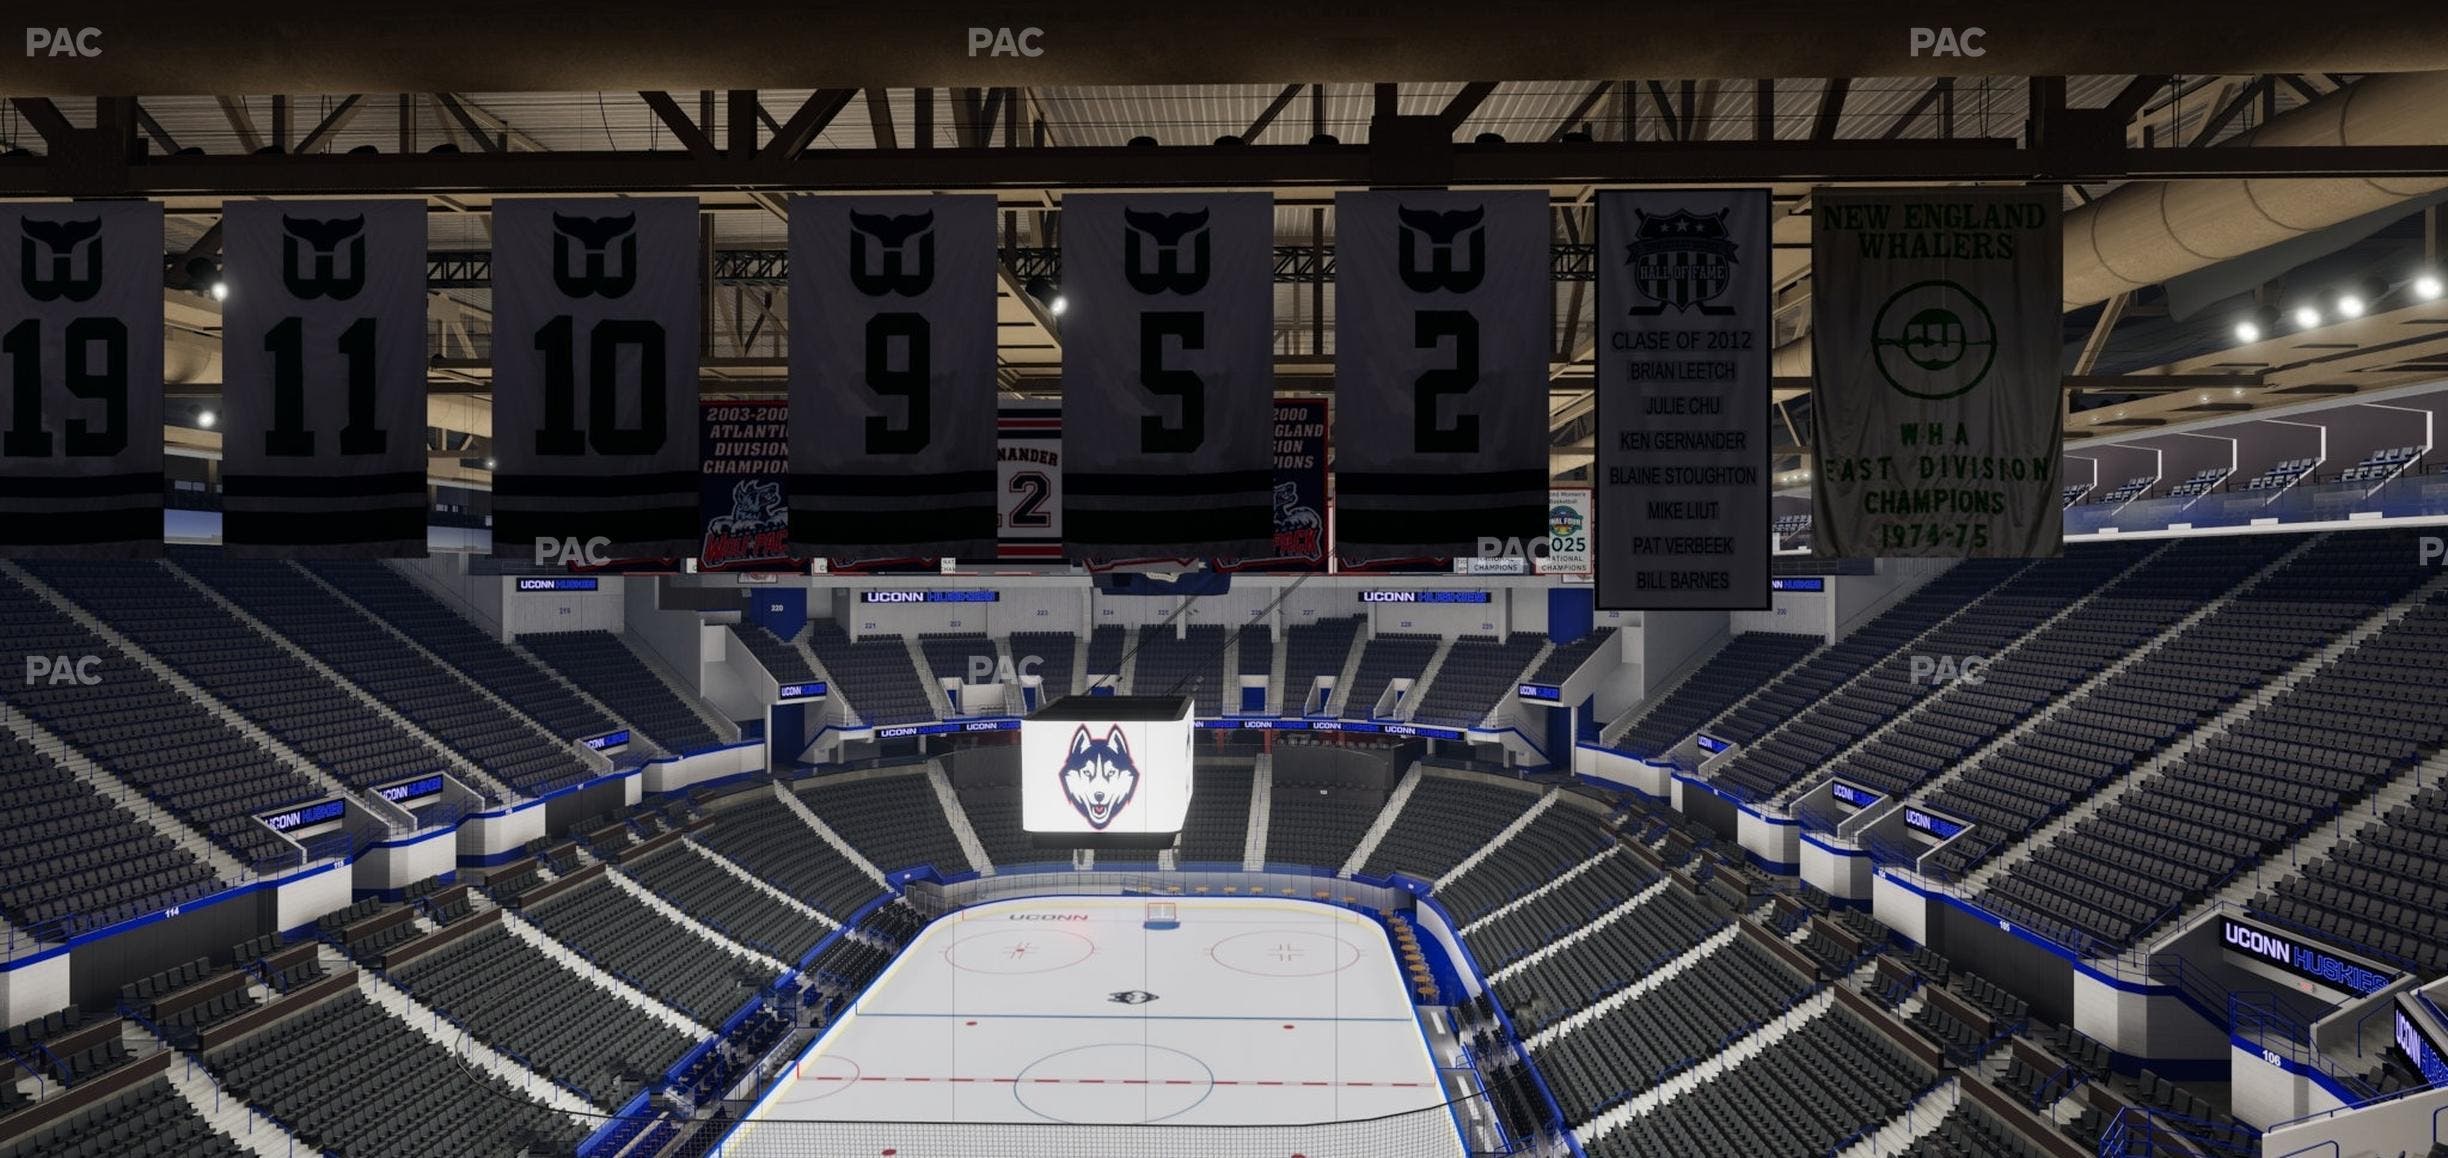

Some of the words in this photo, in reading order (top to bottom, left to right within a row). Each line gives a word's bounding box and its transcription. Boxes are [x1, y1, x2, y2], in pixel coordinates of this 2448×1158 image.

[1822, 204, 1892, 231] NEW
[1903, 202, 2046, 230] ENGLAND
[1857, 232, 2015, 260] WHALERS
[1640, 265, 1669, 280] HALL
[1673, 265, 1689, 280] OF
[1692, 265, 1725, 280] FAME
[1676, 331, 1700, 349] OF
[1707, 331, 1753, 349] 2012
[1630, 361, 1675, 380] BRIAN
[1678, 361, 1736, 380] LEETCH
[3, 317, 128, 456] 19
[264, 316, 387, 456] 11
[534, 315, 667, 455] 10
[865, 312, 930, 454] 9
[1140, 311, 1204, 453] 5
[1414, 310, 1479, 453] 2
[1646, 396, 1685, 415] JULIE
[1688, 396, 1721, 415] CHU
[709, 424, 788, 439] ATLANTI
[1620, 431, 1650, 450] KEN
[1654, 431, 1747, 450] GERNANDER
[1609, 466, 1661, 485] BLAINE
[1664, 466, 1757, 485] STOUGHTON
[1919, 455, 2049, 481] DIVISION
[1864, 488, 2006, 515] CHAMPIONS
[1647, 502, 1683, 520] MIKE
[1687, 502, 1719, 520] LIUT
[1881, 522, 1988, 549] 1974-75
[1632, 536, 1662, 554] PAT
[1664, 536, 1735, 554] VERBEEK
[1474, 564, 1519, 572] CHAMPIONS
[520, 579, 555, 589] UCONN
[1636, 571, 1666, 589] BILL
[1670, 571, 1730, 589] BARNES
[867, 592, 924, 603] UCONN
[1364, 592, 1415, 602] UCONN
[781, 685, 802, 697] UCONN
[880, 728, 917, 738] UCONN
[966, 722, 998, 731] UCONN
[1244, 720, 1273, 729] UCONN
[1312, 722, 1342, 731] UCONN
[1384, 725, 1416, 735] UCONN
[1834, 783, 1854, 801] UCONN
[1906, 809, 1931, 830] UCONN
[165, 906, 180, 919] 114
[1009, 913, 1089, 921] UCONN
[2225, 922, 2291, 964] UCONN
[2293, 945, 2390, 995] HUSKIES
[2394, 1008, 2422, 1070] UCONN
[2261, 1050, 2282, 1068] 106
